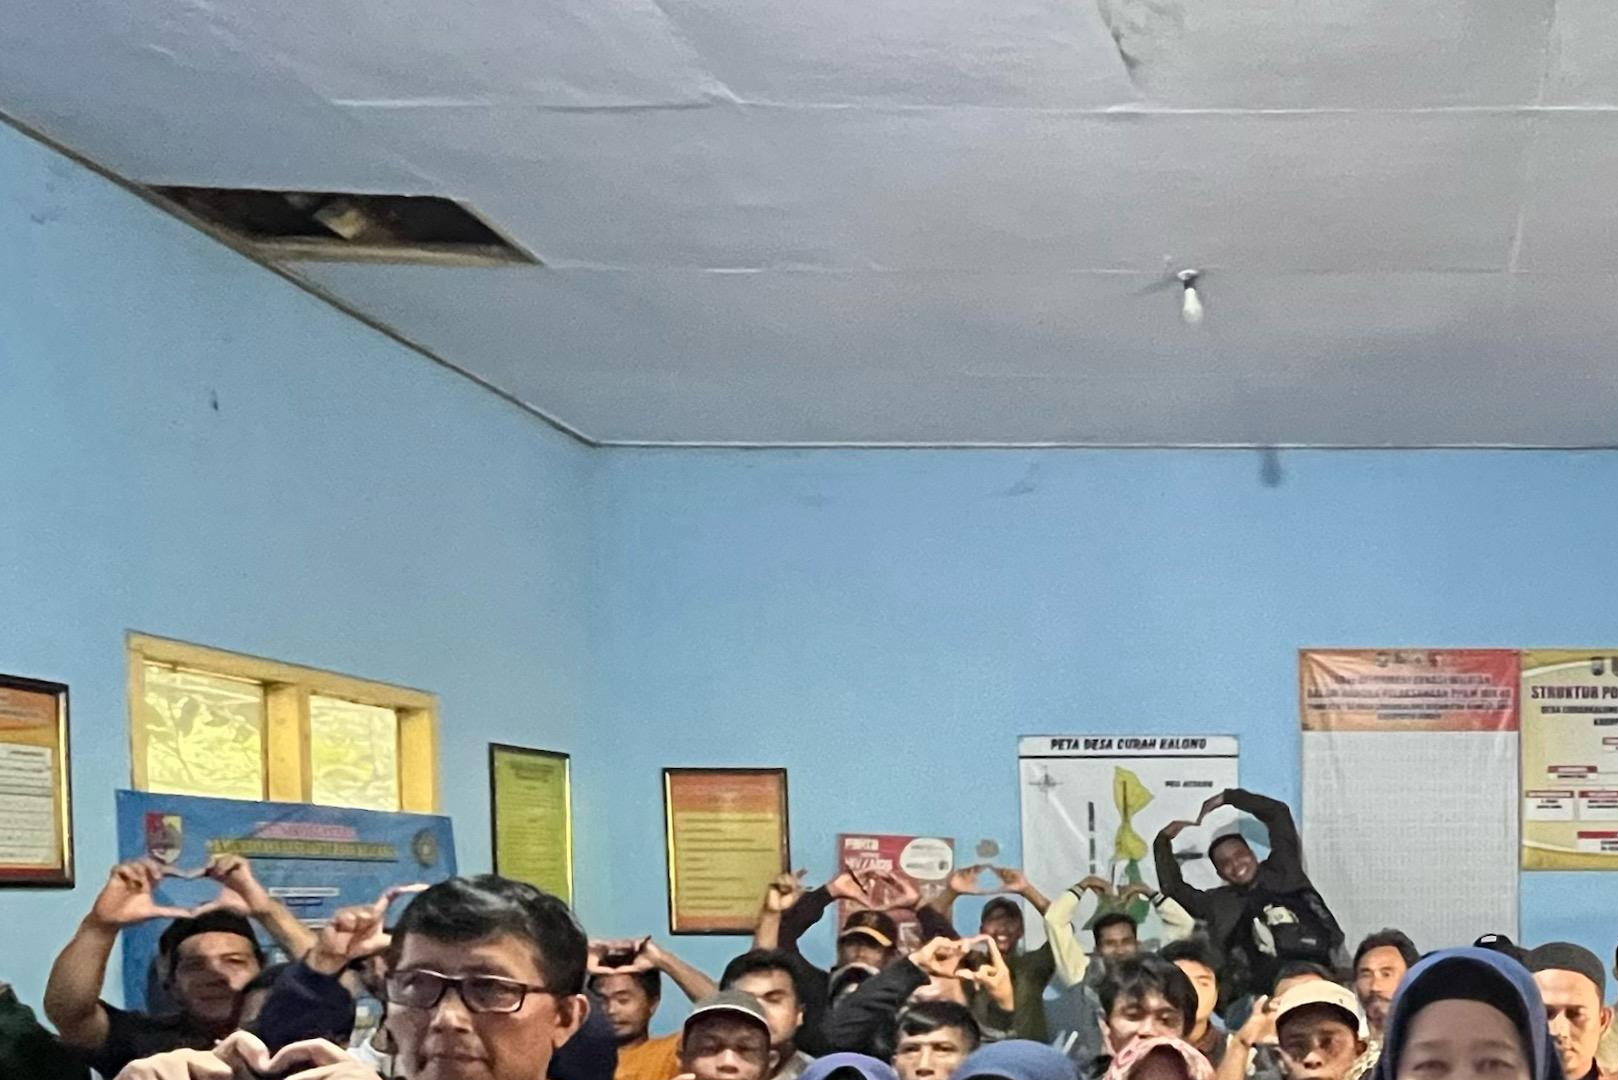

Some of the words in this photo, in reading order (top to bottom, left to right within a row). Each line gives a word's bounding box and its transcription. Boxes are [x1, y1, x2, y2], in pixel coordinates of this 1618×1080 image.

[1531, 686, 1598, 699] STRUKTUR
[1050, 738, 1080, 750] PETA
[1083, 738, 1113, 750] DESA
[1117, 738, 1157, 750] CURAH
